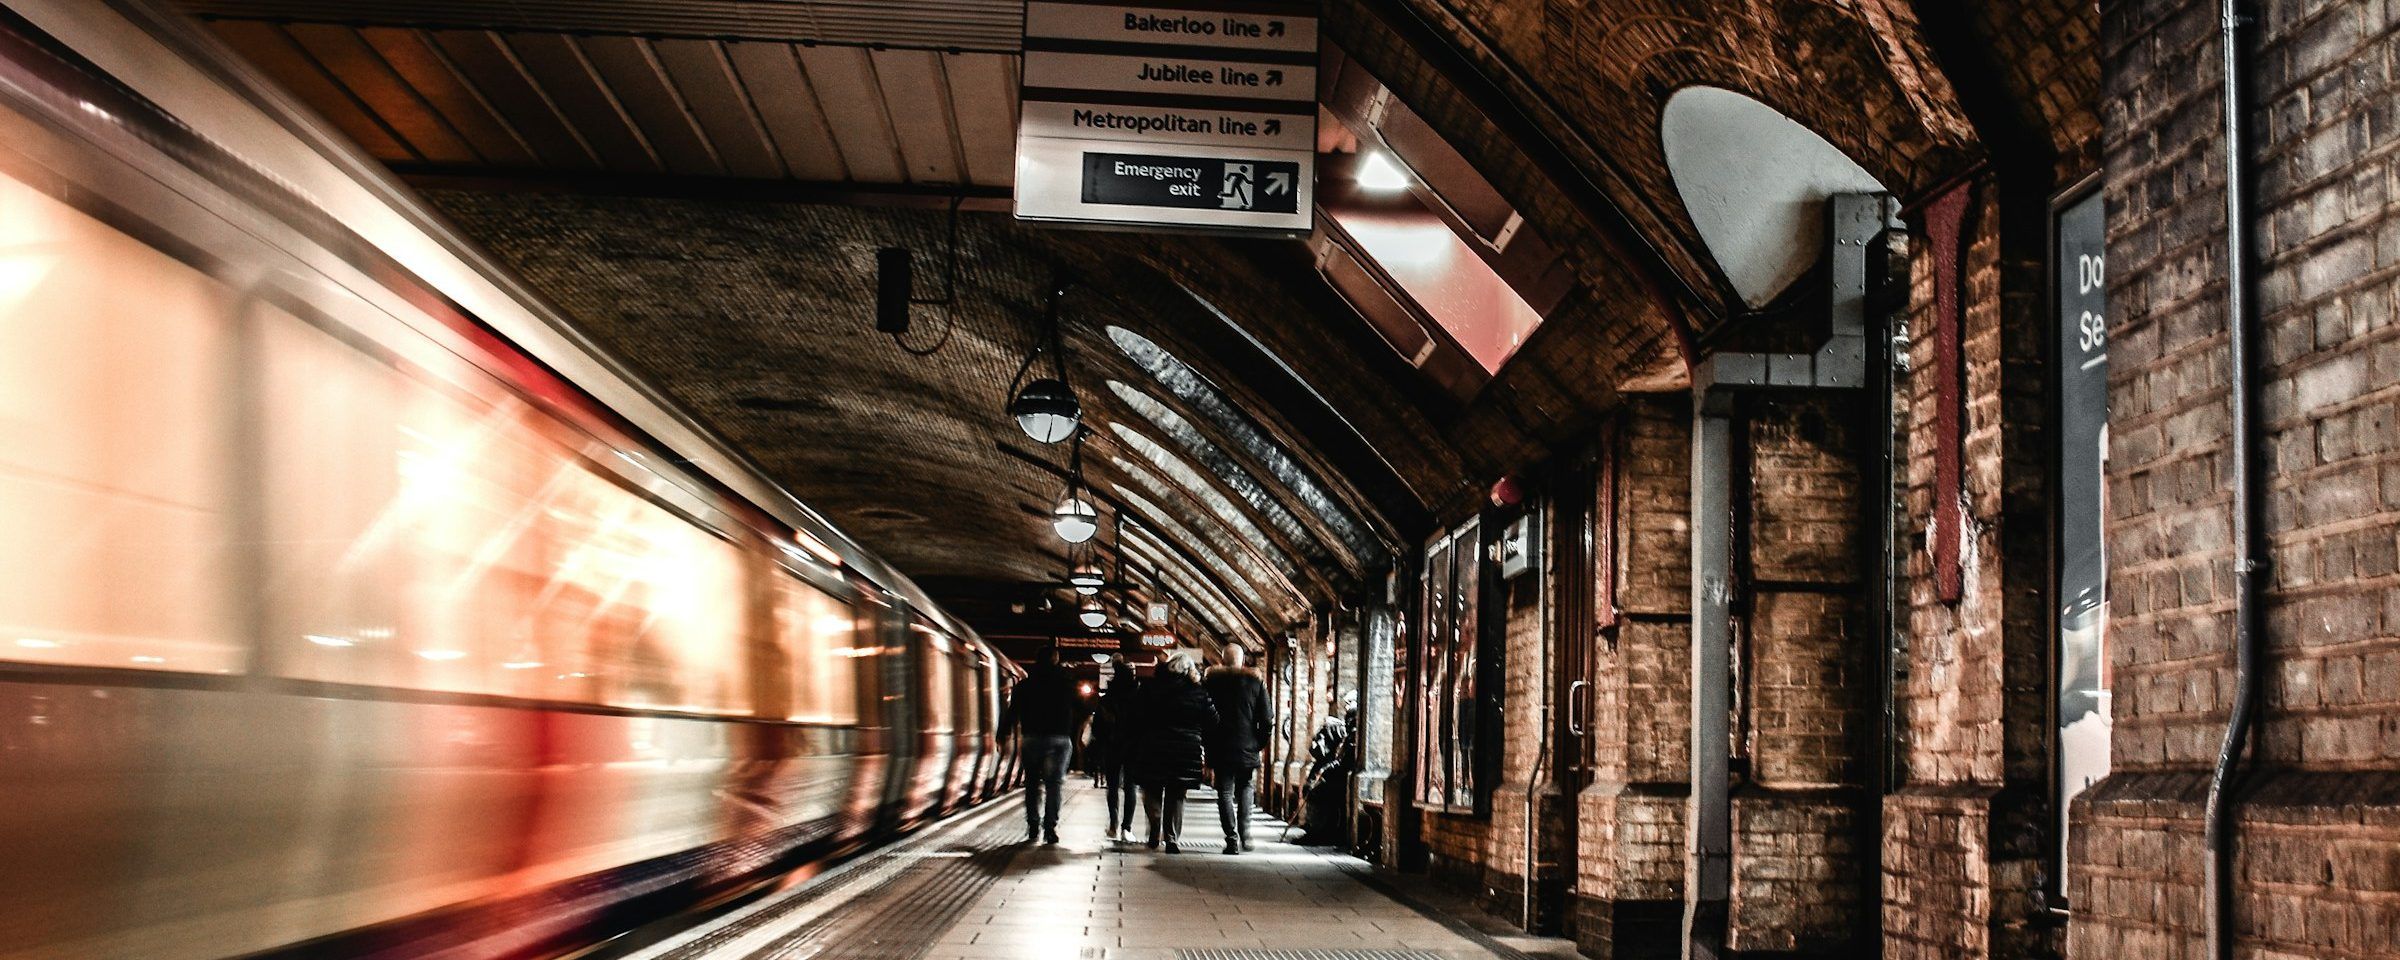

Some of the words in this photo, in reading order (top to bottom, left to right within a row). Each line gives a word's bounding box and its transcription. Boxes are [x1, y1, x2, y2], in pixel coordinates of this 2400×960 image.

[1125, 13, 1216, 35] Bakerloo
[1223, 18, 1261, 38] line
[1137, 63, 1213, 84] Jubilee
[1221, 67, 1259, 87] line
[1073, 109, 1211, 134] Metropolitan
[1219, 116, 1257, 136] line
[1114, 161, 1202, 182] Emergency
[1169, 182, 1201, 197] exit
[2079, 249, 2105, 295] Do
[2080, 310, 2105, 352] Se
